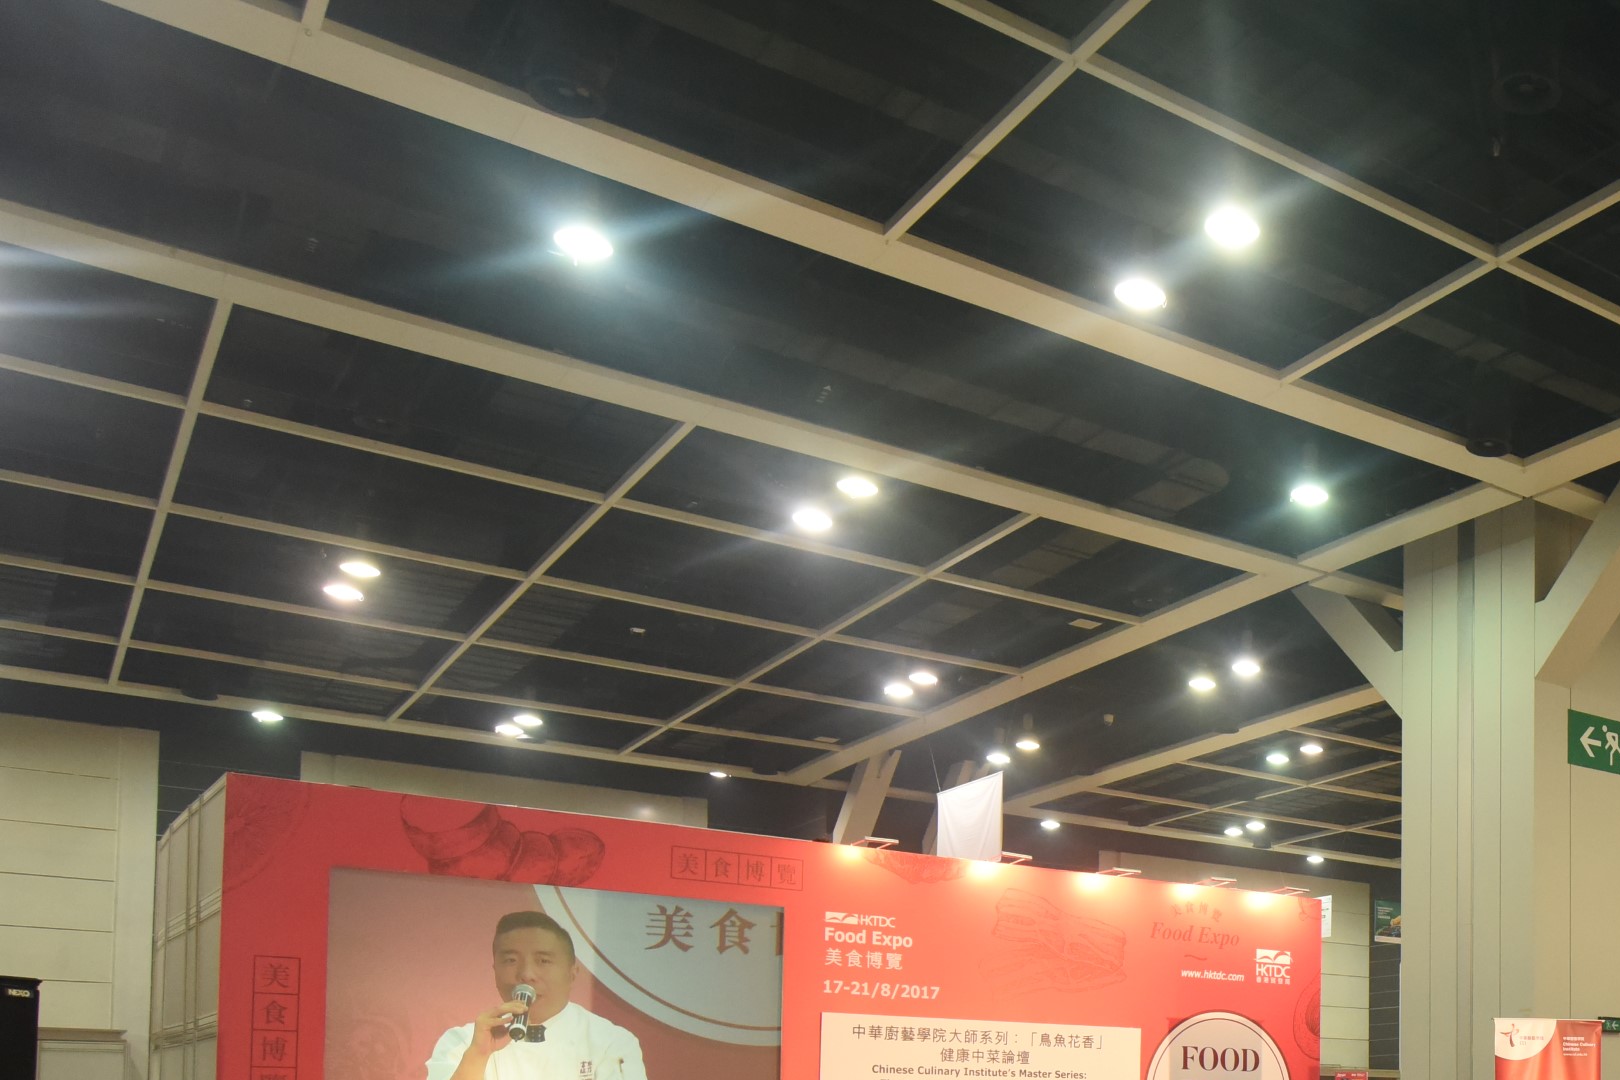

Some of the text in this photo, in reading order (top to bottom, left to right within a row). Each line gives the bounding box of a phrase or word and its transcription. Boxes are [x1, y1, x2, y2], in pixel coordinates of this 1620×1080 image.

[679, 853, 796, 885] 美食博覽
[645, 904, 784, 955] 美食
[859, 915, 896, 928] HKTDC
[824, 928, 913, 949] Food Expo
[1150, 921, 1240, 949] Food Expo
[825, 948, 903, 970] 美食博覽
[1181, 969, 1245, 982] www.hktdc.com
[1256, 964, 1291, 978] HKTDC
[823, 980, 940, 1000] 17-21/8/2017
[940, 1048, 1031, 1065] 健康中菜論壇
[1181, 1045, 1260, 1072] FOOD
[872, 1064, 915, 1075] Chinese
[918, 1066, 961, 1078] Culinary
[1019, 1069, 1052, 1079] Master
[1054, 1070, 1087, 1080] Series:
